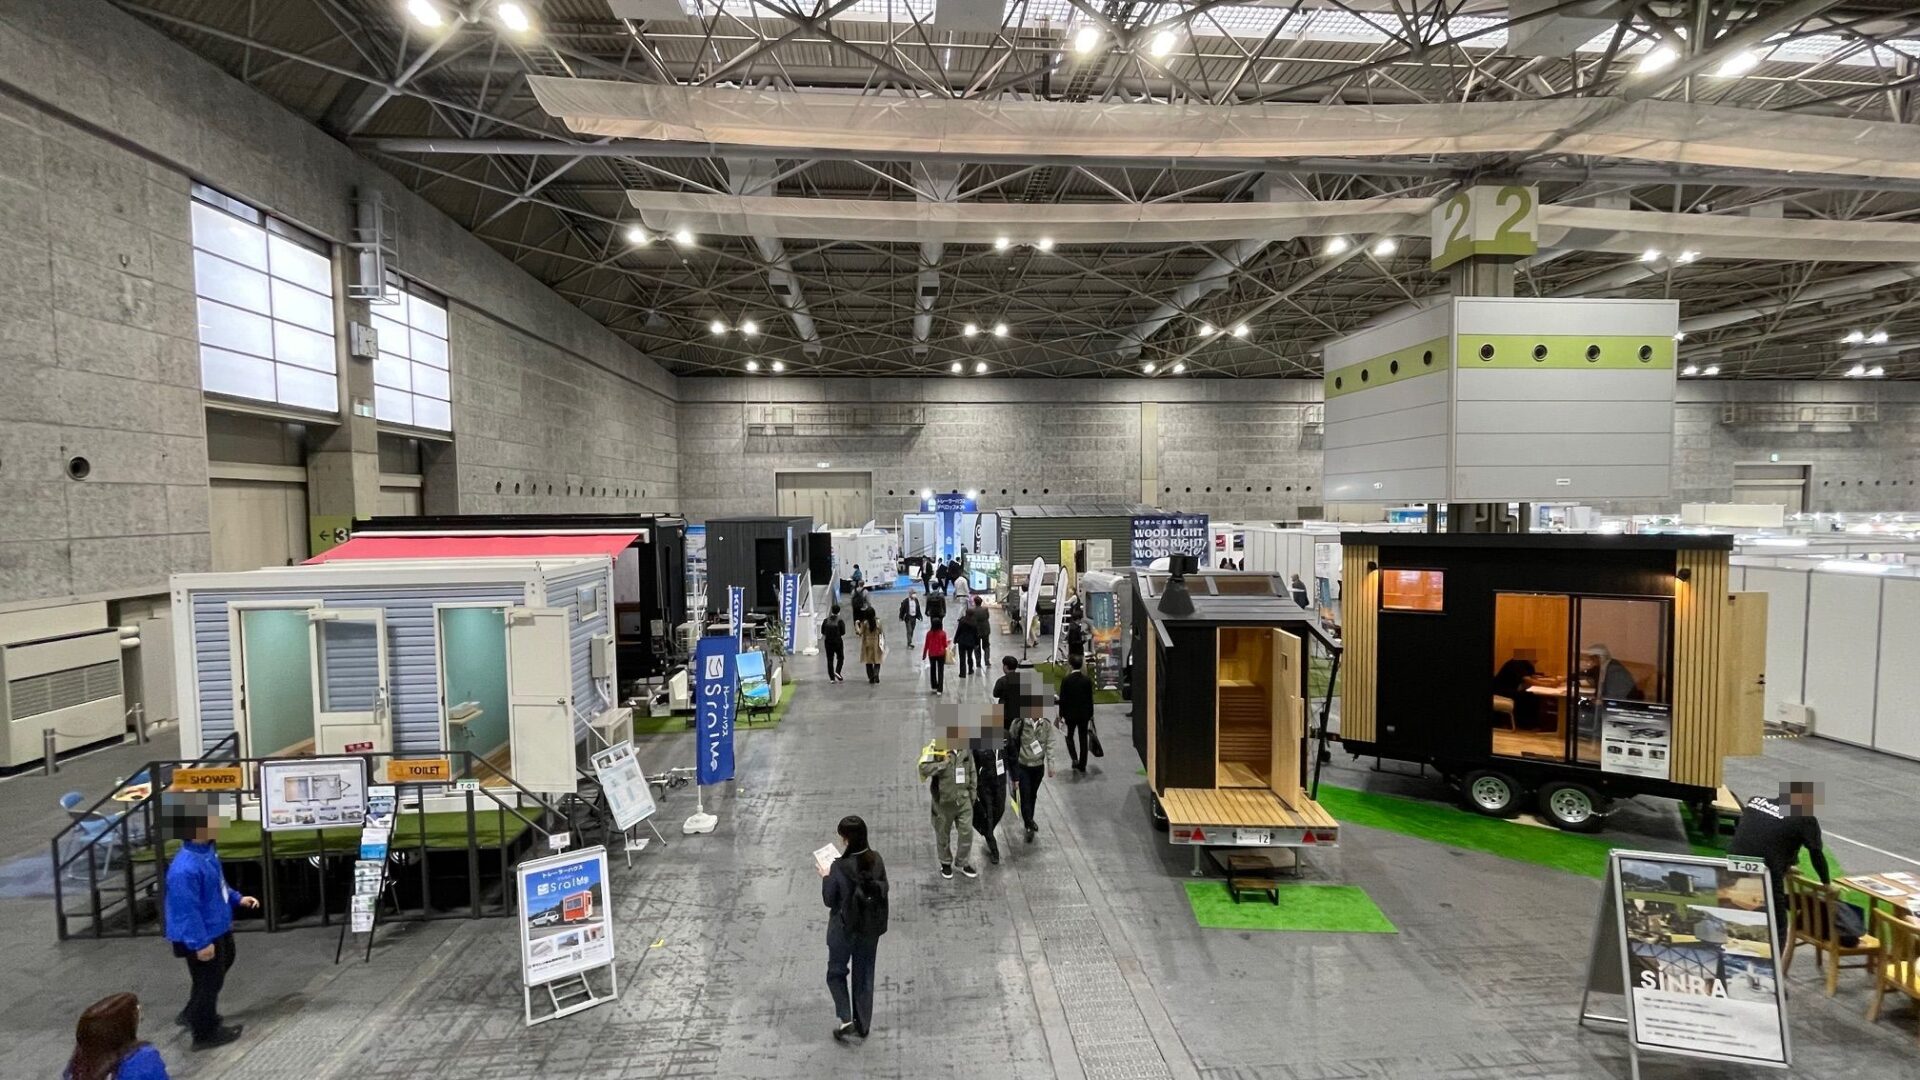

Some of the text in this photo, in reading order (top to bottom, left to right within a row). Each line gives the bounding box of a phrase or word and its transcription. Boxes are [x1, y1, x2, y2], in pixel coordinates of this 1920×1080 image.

[1494, 186, 1532, 243] 2
[1444, 191, 1471, 255] 2
[335, 527, 348, 544] 3
[1134, 528, 1204, 538] WOOD LIGHT
[1134, 538, 1204, 548] WOOD RIGHT
[1134, 549, 1169, 558] WOOD
[722, 686, 730, 737] トレーラーハウス
[408, 766, 440, 775] TOILET
[190, 774, 236, 785] SHOWER
[1734, 861, 1759, 872] T-02
